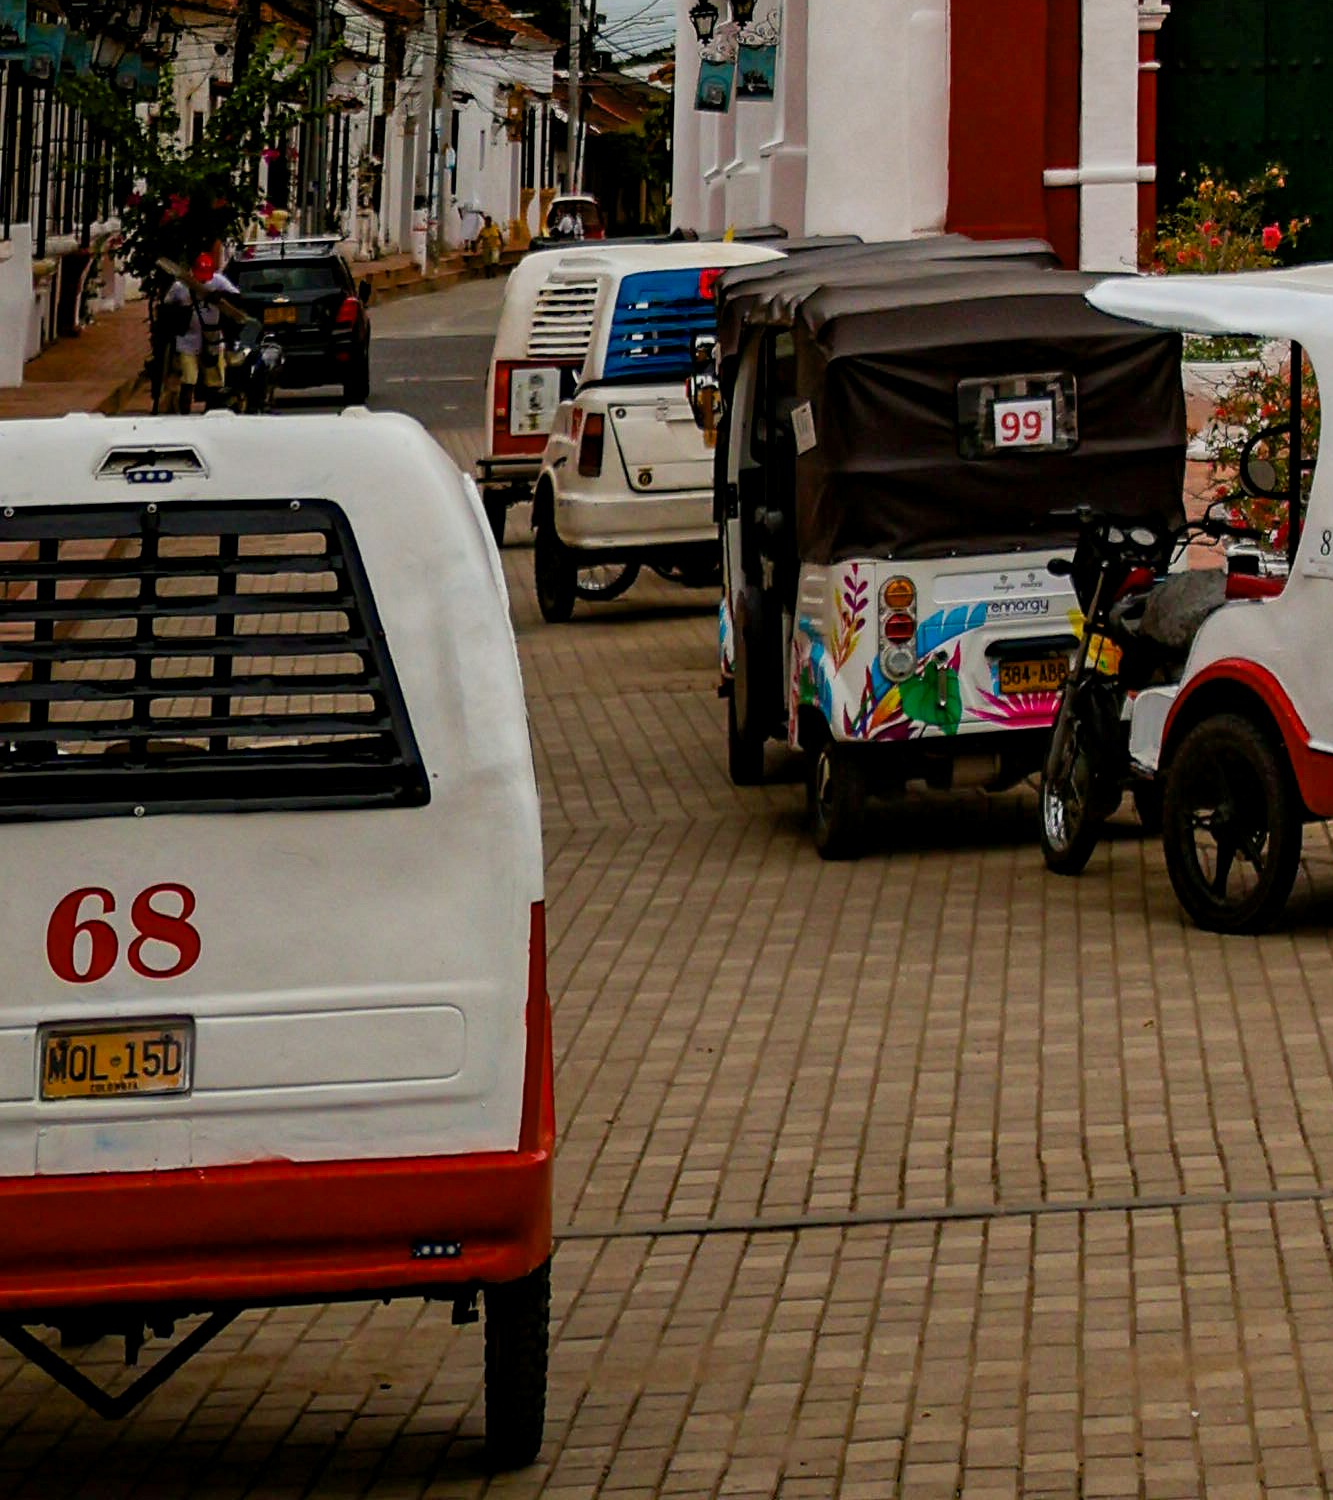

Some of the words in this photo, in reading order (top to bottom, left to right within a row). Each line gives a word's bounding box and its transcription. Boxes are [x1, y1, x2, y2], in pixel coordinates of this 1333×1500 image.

[1001, 411, 1042, 442] 99
[1320, 530, 1332, 556] 8
[47, 883, 201, 983] 68
